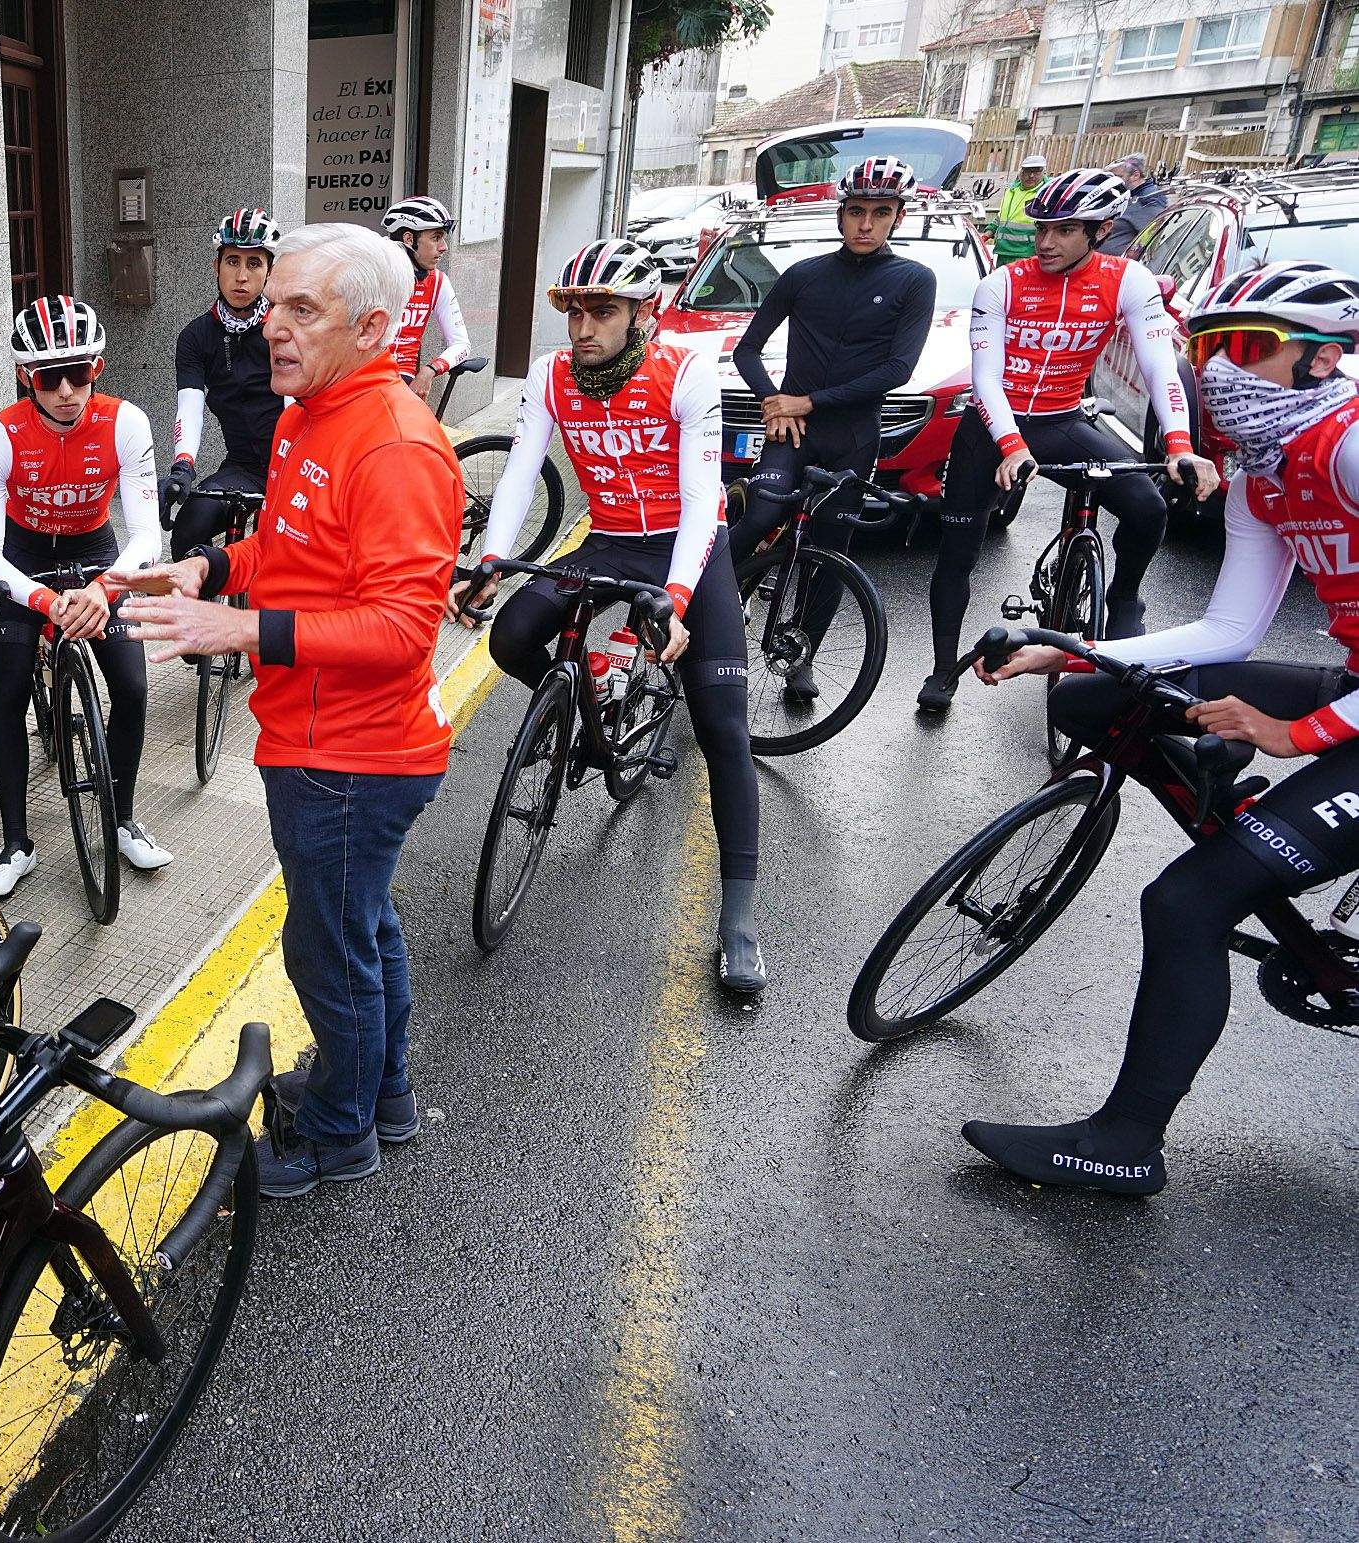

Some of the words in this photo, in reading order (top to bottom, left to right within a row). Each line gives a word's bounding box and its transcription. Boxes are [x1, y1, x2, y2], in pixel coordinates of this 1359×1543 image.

[338, 82, 357, 97] El
[313, 106, 341, 121] del
[348, 105, 383, 120] G.D.
[317, 128, 369, 143] hacer
[323, 153, 355, 165] con
[308, 173, 373, 189] FUERZO
[378, 175, 390, 189] y
[323, 200, 346, 212] en
[1080, 304, 1098, 312] BH
[1007, 317, 1109, 329] supermercados
[1005, 324, 1106, 352] FROIZ
[628, 400, 647, 410] BH
[1167, 382, 1185, 413] FROIZ
[565, 425, 671, 458] FROIZ
[85, 467, 101, 475] BH
[17, 483, 108, 507] FROIZ
[290, 491, 309, 511] BH
[1301, 488, 1313, 501] BH
[1235, 811, 1316, 876] TTOBOSLEY
[1053, 1153, 1152, 1179] OTTOBOSLEY
